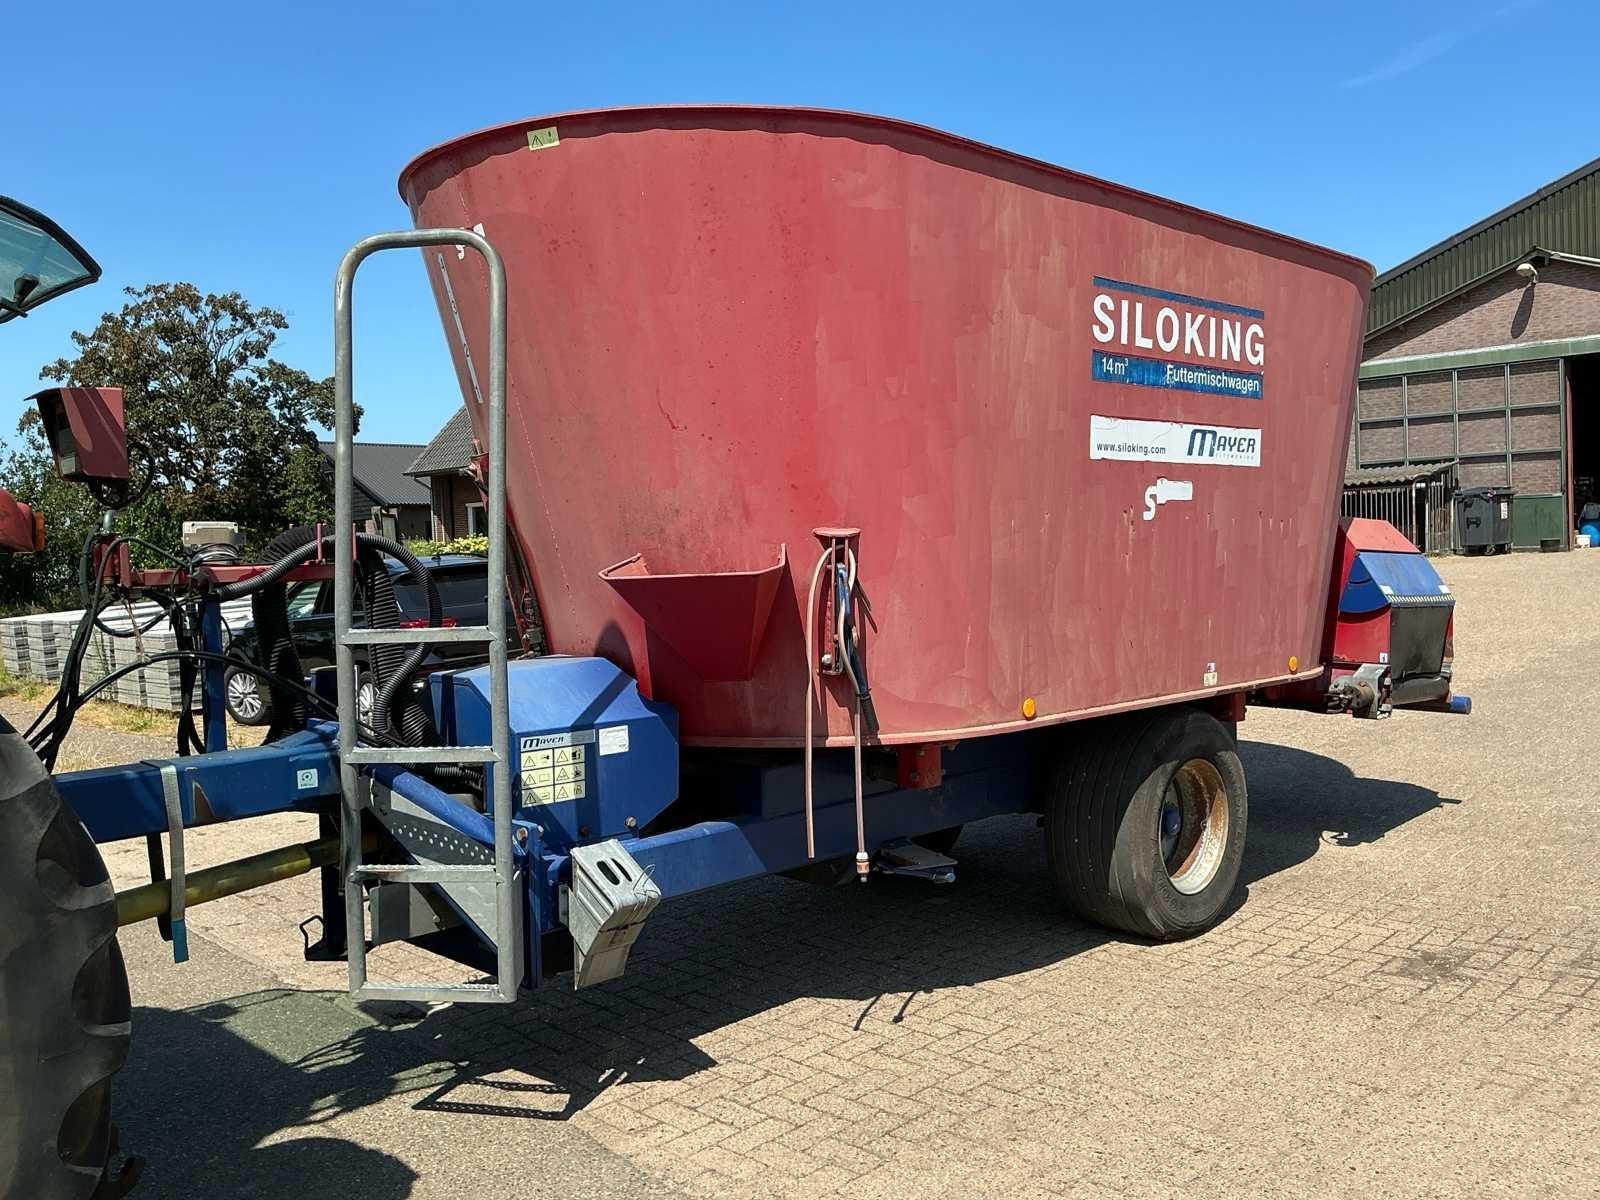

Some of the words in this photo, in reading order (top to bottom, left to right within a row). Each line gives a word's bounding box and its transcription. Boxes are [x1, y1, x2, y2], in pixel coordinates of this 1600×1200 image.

[1092, 294, 1265, 367] SILOKING
[1166, 364, 1260, 395] Futtermischwagen
[1096, 442, 1166, 456] www.siloking.com
[1187, 428, 1256, 457] MAYER
